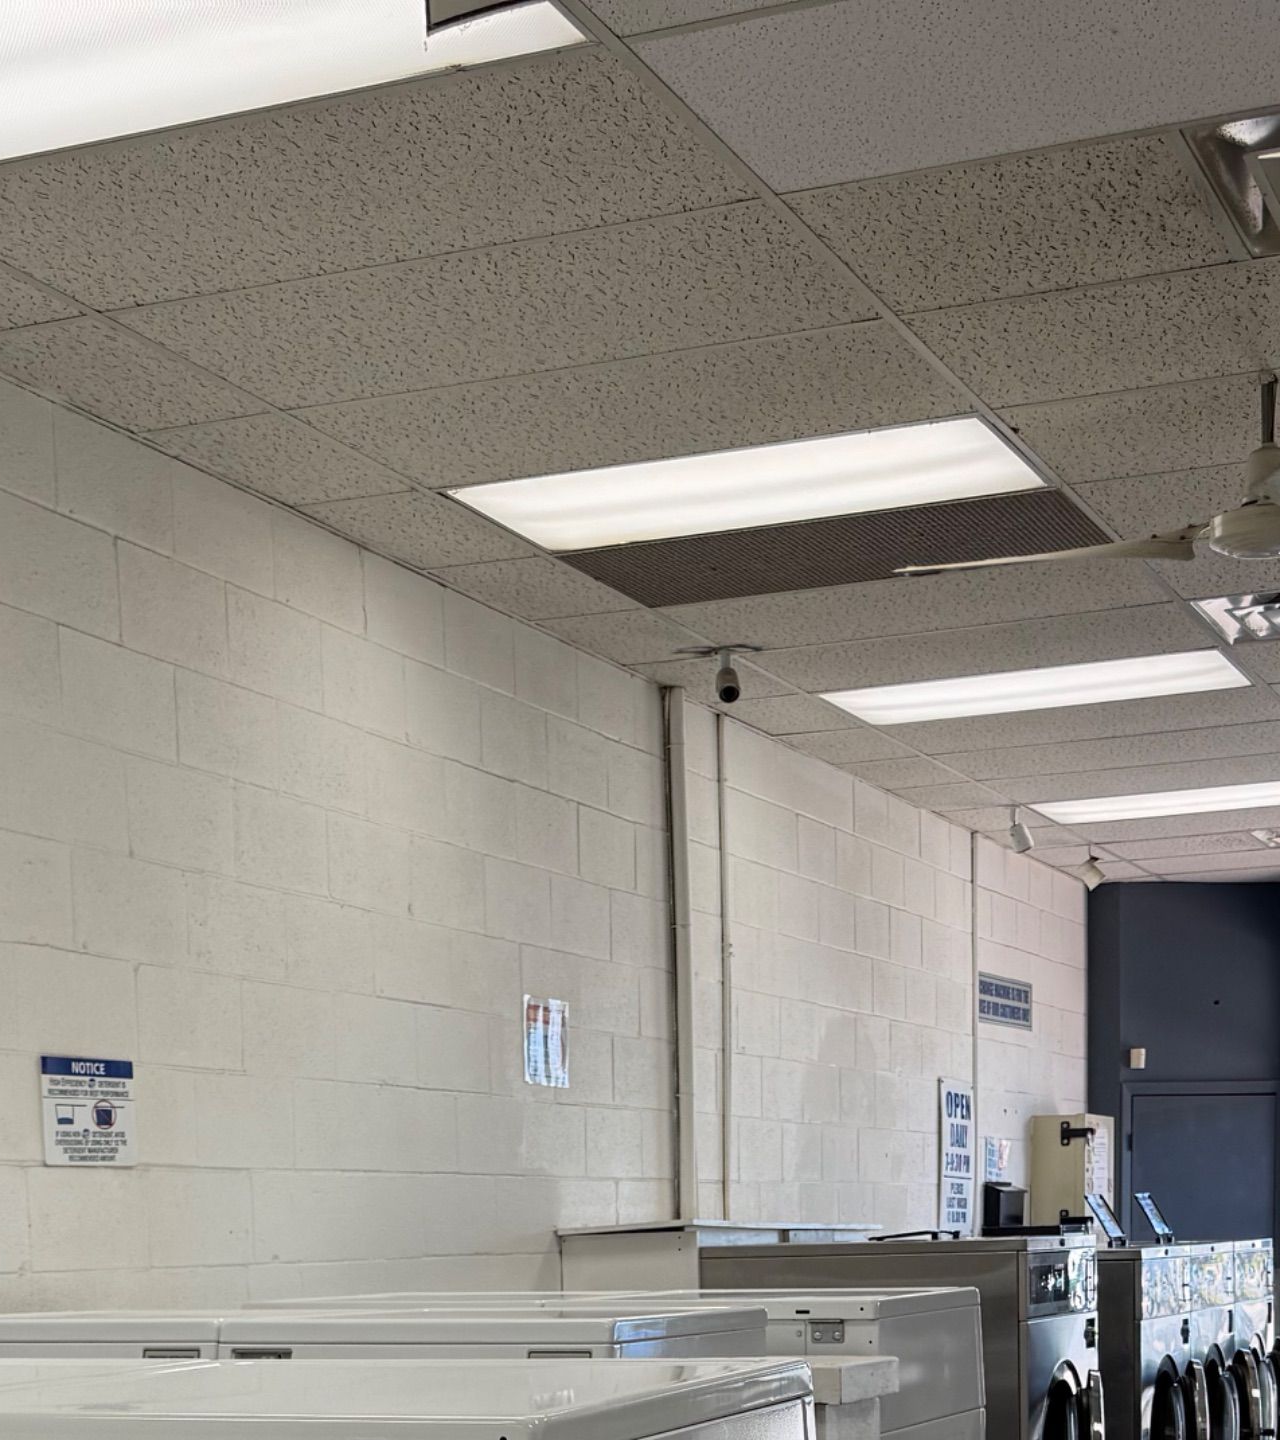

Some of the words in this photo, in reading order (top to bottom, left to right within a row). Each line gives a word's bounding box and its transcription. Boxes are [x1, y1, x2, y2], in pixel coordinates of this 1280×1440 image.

[71, 1061, 106, 1075] NOTICE
[946, 1091, 971, 1120] OPEN
[950, 1123, 968, 1148] DAILY
